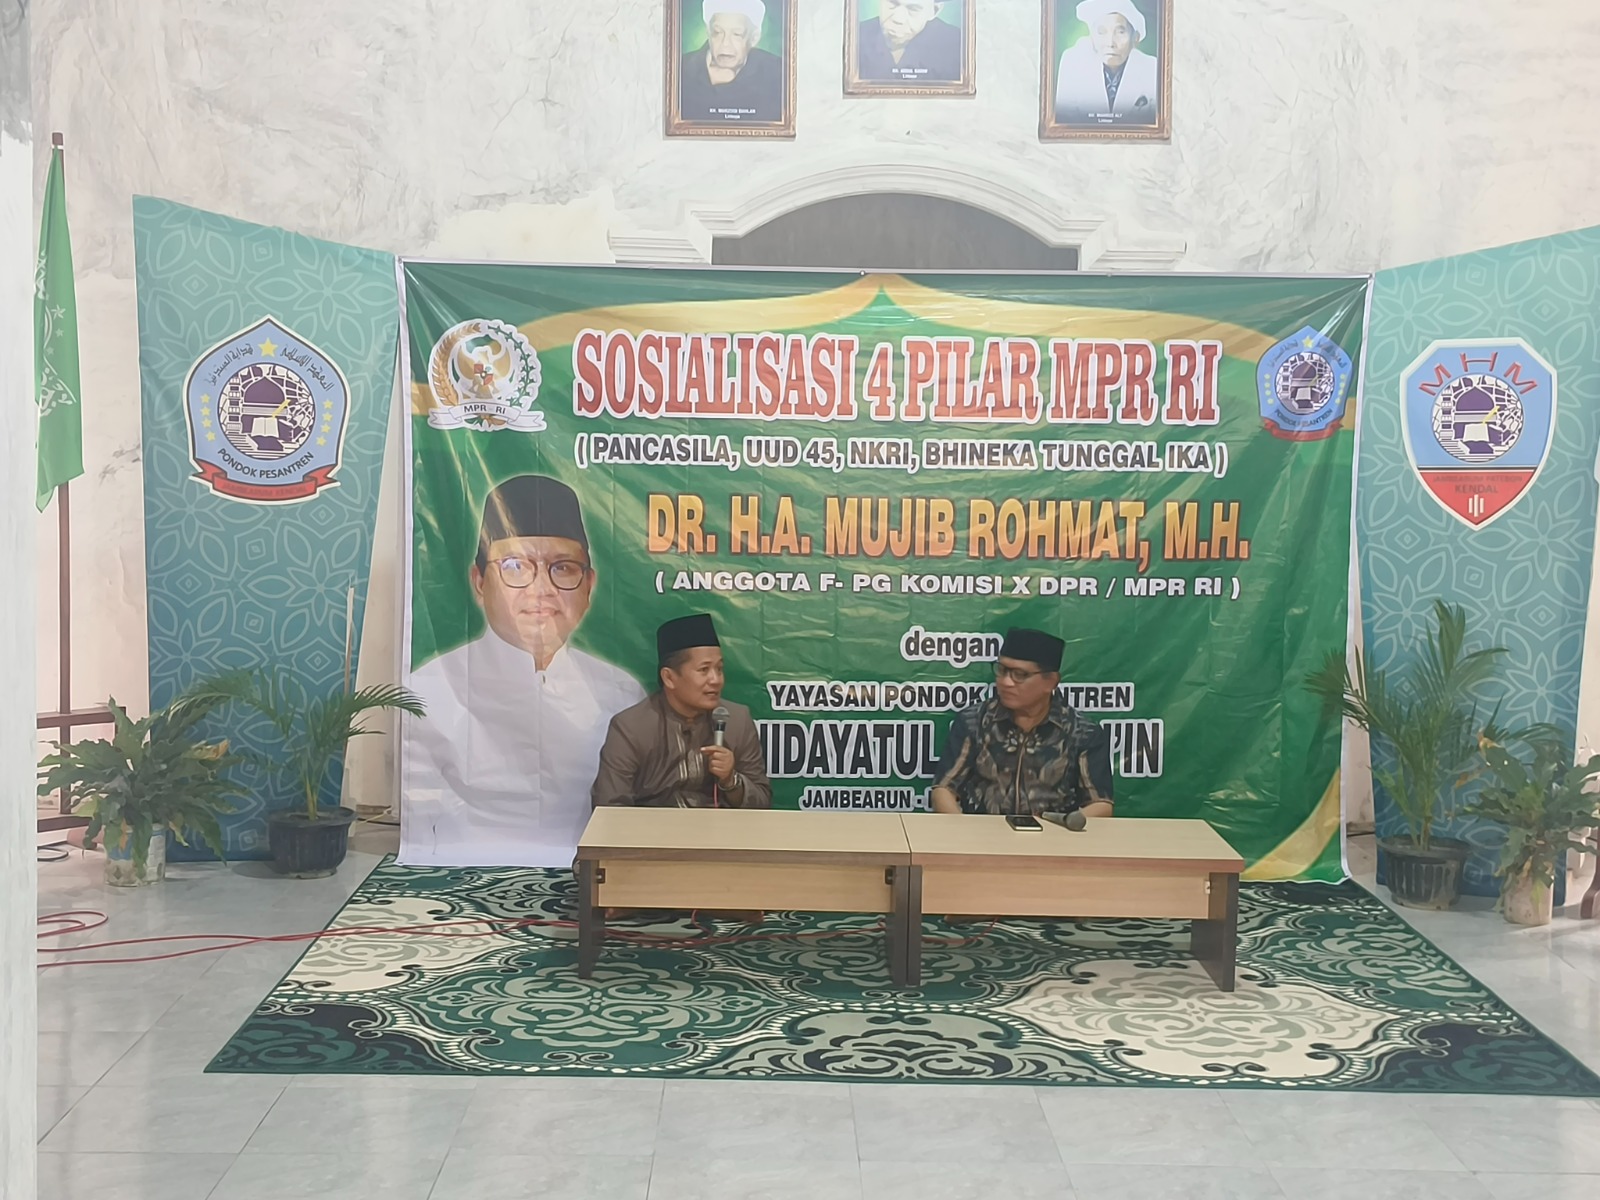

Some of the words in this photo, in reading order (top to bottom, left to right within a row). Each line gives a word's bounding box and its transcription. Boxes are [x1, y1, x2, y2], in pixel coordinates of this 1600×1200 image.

[575, 331, 857, 418] SOSIALISASI
[866, 345, 893, 418] 4
[903, 338, 1041, 421] PILAR
[1049, 340, 1156, 424] MPR
[1164, 341, 1220, 424] RI
[1418, 352, 1538, 396] MHM
[463, 404, 487, 414] MPR
[495, 406, 506, 414] RI
[217, 447, 257, 478] PONDOK
[259, 451, 315, 479] PESANTREN
[593, 436, 738, 467] PANCASILA,
[746, 439, 798, 463] UUD
[806, 440, 842, 468] 45,
[850, 441, 917, 469] NKRI,
[925, 442, 1035, 467] BHINEKA
[1042, 443, 1160, 468] TUNGGAL
[1168, 444, 1210, 469] IKA
[1454, 483, 1499, 493] KENDAL
[648, 494, 717, 553] DR.
[730, 495, 811, 555] H.A.
[825, 497, 955, 557] MUJIB
[968, 498, 1150, 573] ROHMAT,
[1163, 501, 1249, 560] M.H.
[672, 571, 811, 591] ANGGOTA
[819, 573, 844, 592] F-
[852, 574, 892, 593] PG
[901, 575, 1002, 595] KOMISI
[1011, 576, 1031, 595] X
[1039, 577, 1098, 596] DPR
[1124, 577, 1185, 596] MPR
[1194, 577, 1222, 596] RI
[904, 630, 1000, 663] dengan
[770, 684, 876, 707] YAYASAN
[884, 685, 986, 708] PONDOK
[802, 789, 912, 809] JAMBEARUN
